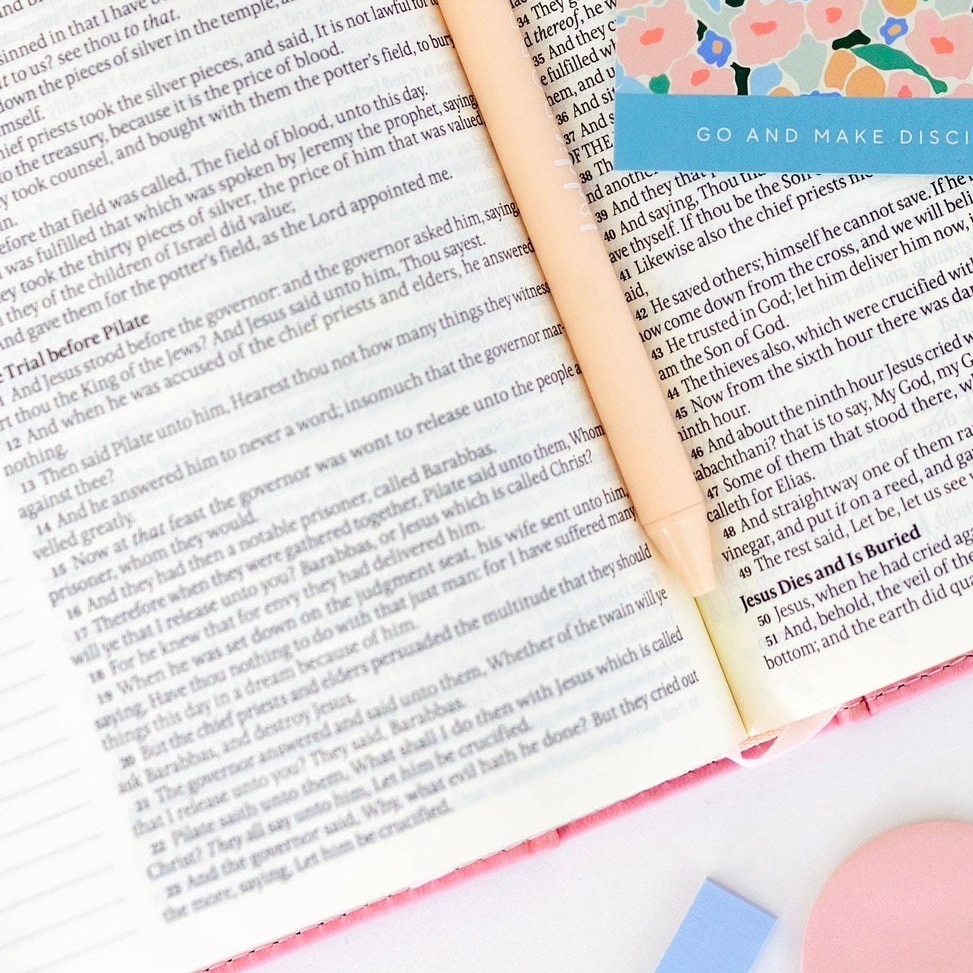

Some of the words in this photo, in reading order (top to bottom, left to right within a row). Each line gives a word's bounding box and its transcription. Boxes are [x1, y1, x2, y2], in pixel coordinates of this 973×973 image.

[697, 127, 731, 141] GO
[747, 128, 797, 142] AND
[815, 129, 883, 143] MAKE
[3, 351, 46, 379] Trial
[46, 334, 101, 363] before
[102, 314, 150, 341] Pilate
[658, 364, 680, 381] am
[679, 353, 704, 371] the
[703, 341, 734, 361] Son
[734, 328, 751, 348] of
[752, 314, 790, 340] God.
[675, 407, 688, 420] 45
[689, 390, 723, 414] Now
[726, 374, 766, 398] from
[767, 362, 794, 381] the
[795, 343, 835, 370] sixth
[834, 327, 874, 352] hour
[876, 310, 919, 335] there
[919, 296, 950, 316] was
[18, 488, 73, 521] against
[74, 468, 114, 497] thee?
[707, 494, 750, 523] calleth
[751, 486, 774, 505] for
[774, 471, 816, 494] Elias.
[739, 587, 778, 614] Jesus
[777, 573, 814, 596] Dies
[814, 555, 846, 581] and
[845, 552, 864, 567] Is
[863, 523, 922, 560] Buried
[765, 633, 779, 647] 51
[784, 616, 817, 641] And,
[815, 592, 875, 626] behold,
[875, 583, 902, 602] the
[902, 566, 931, 589] veil
[933, 557, 950, 578] of
